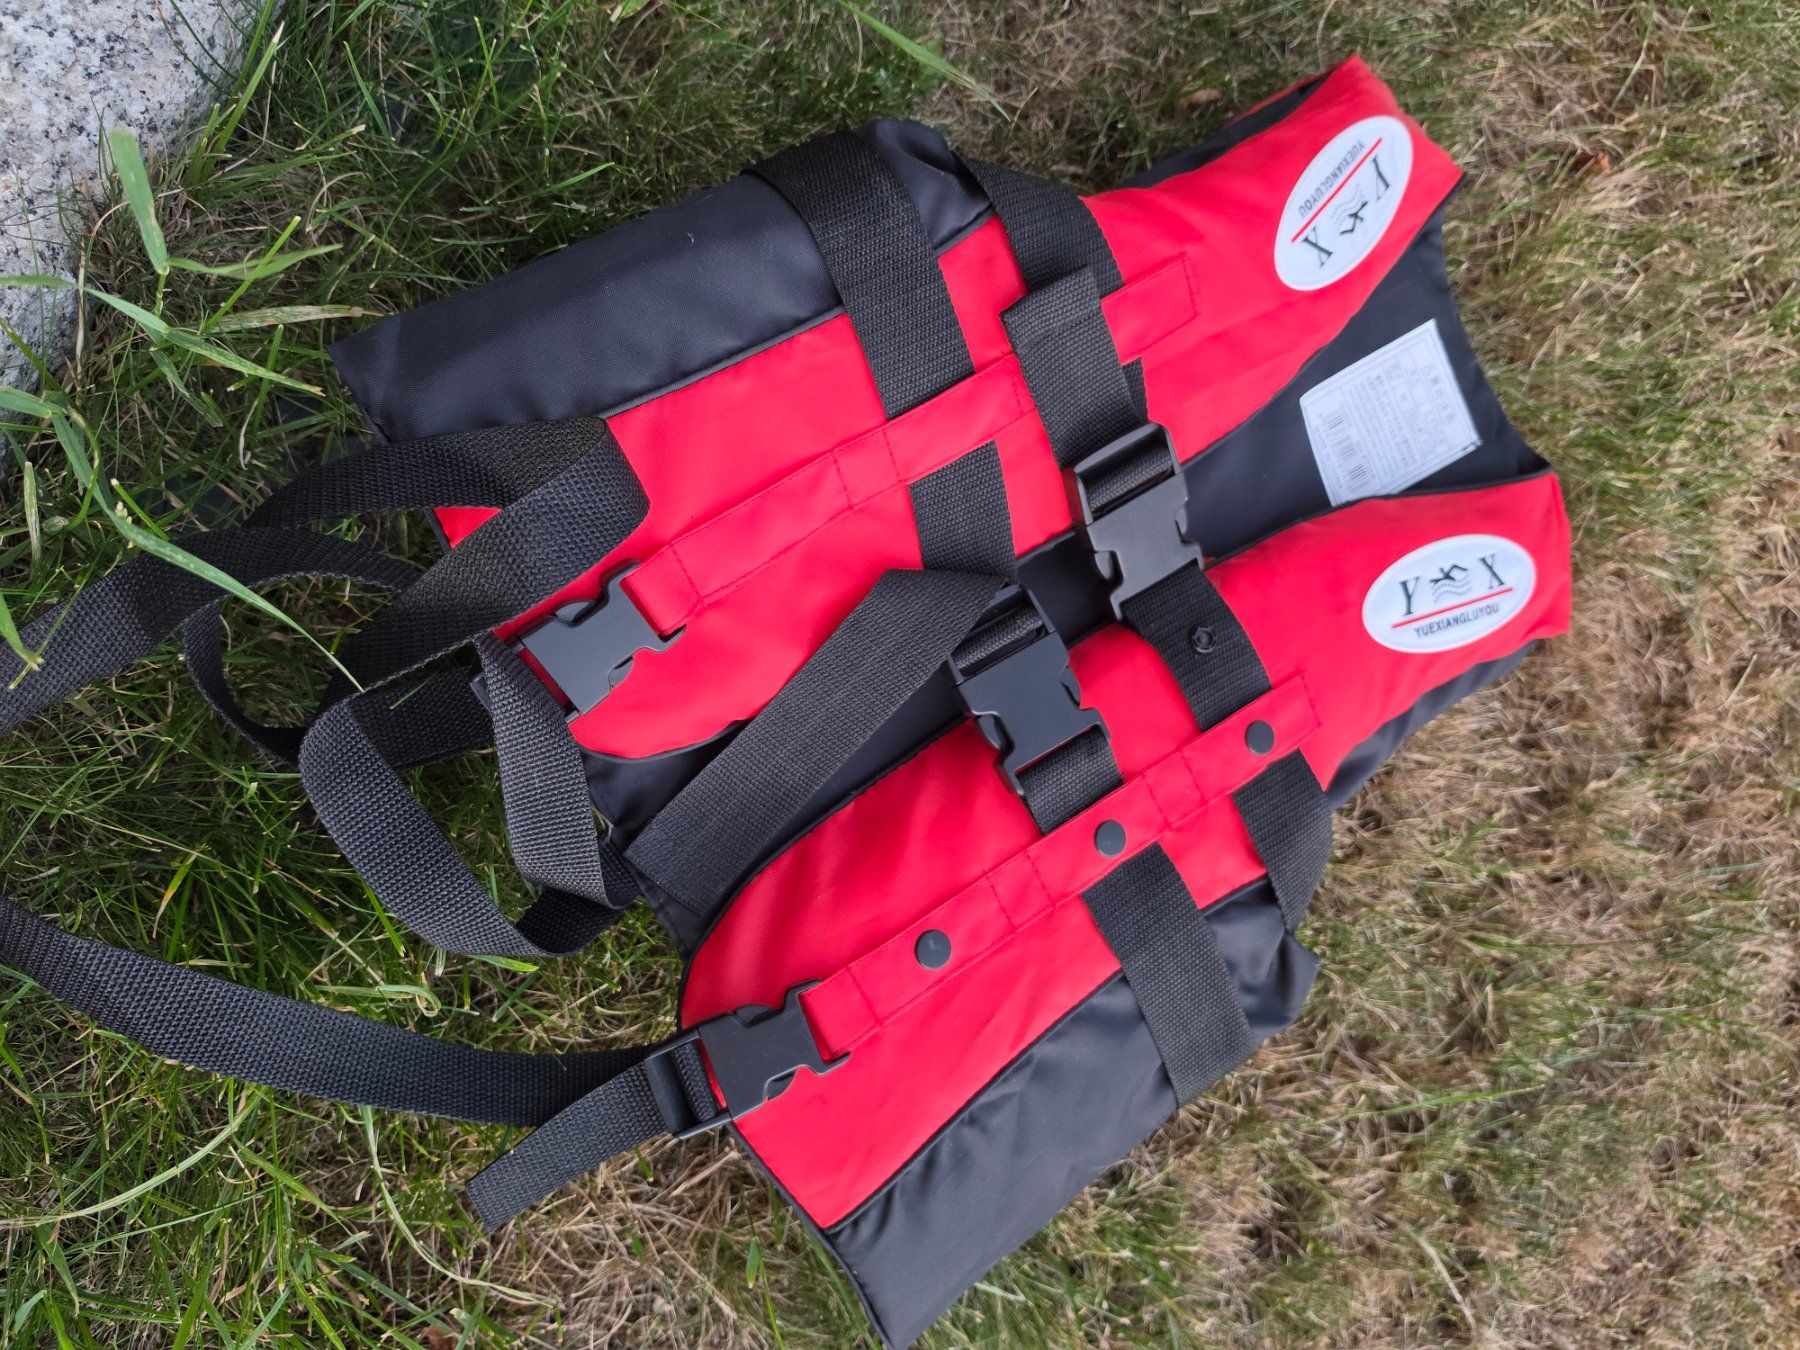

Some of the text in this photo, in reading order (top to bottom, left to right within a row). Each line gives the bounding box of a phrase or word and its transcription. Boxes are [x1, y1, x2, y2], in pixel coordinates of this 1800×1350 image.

[1298, 140, 1365, 219] YUEXIANGLUYOU
[1302, 154, 1390, 268] Y X
[1399, 553, 1505, 616] Y X
[1414, 602, 1499, 638] YUEXIANGLUYOU
